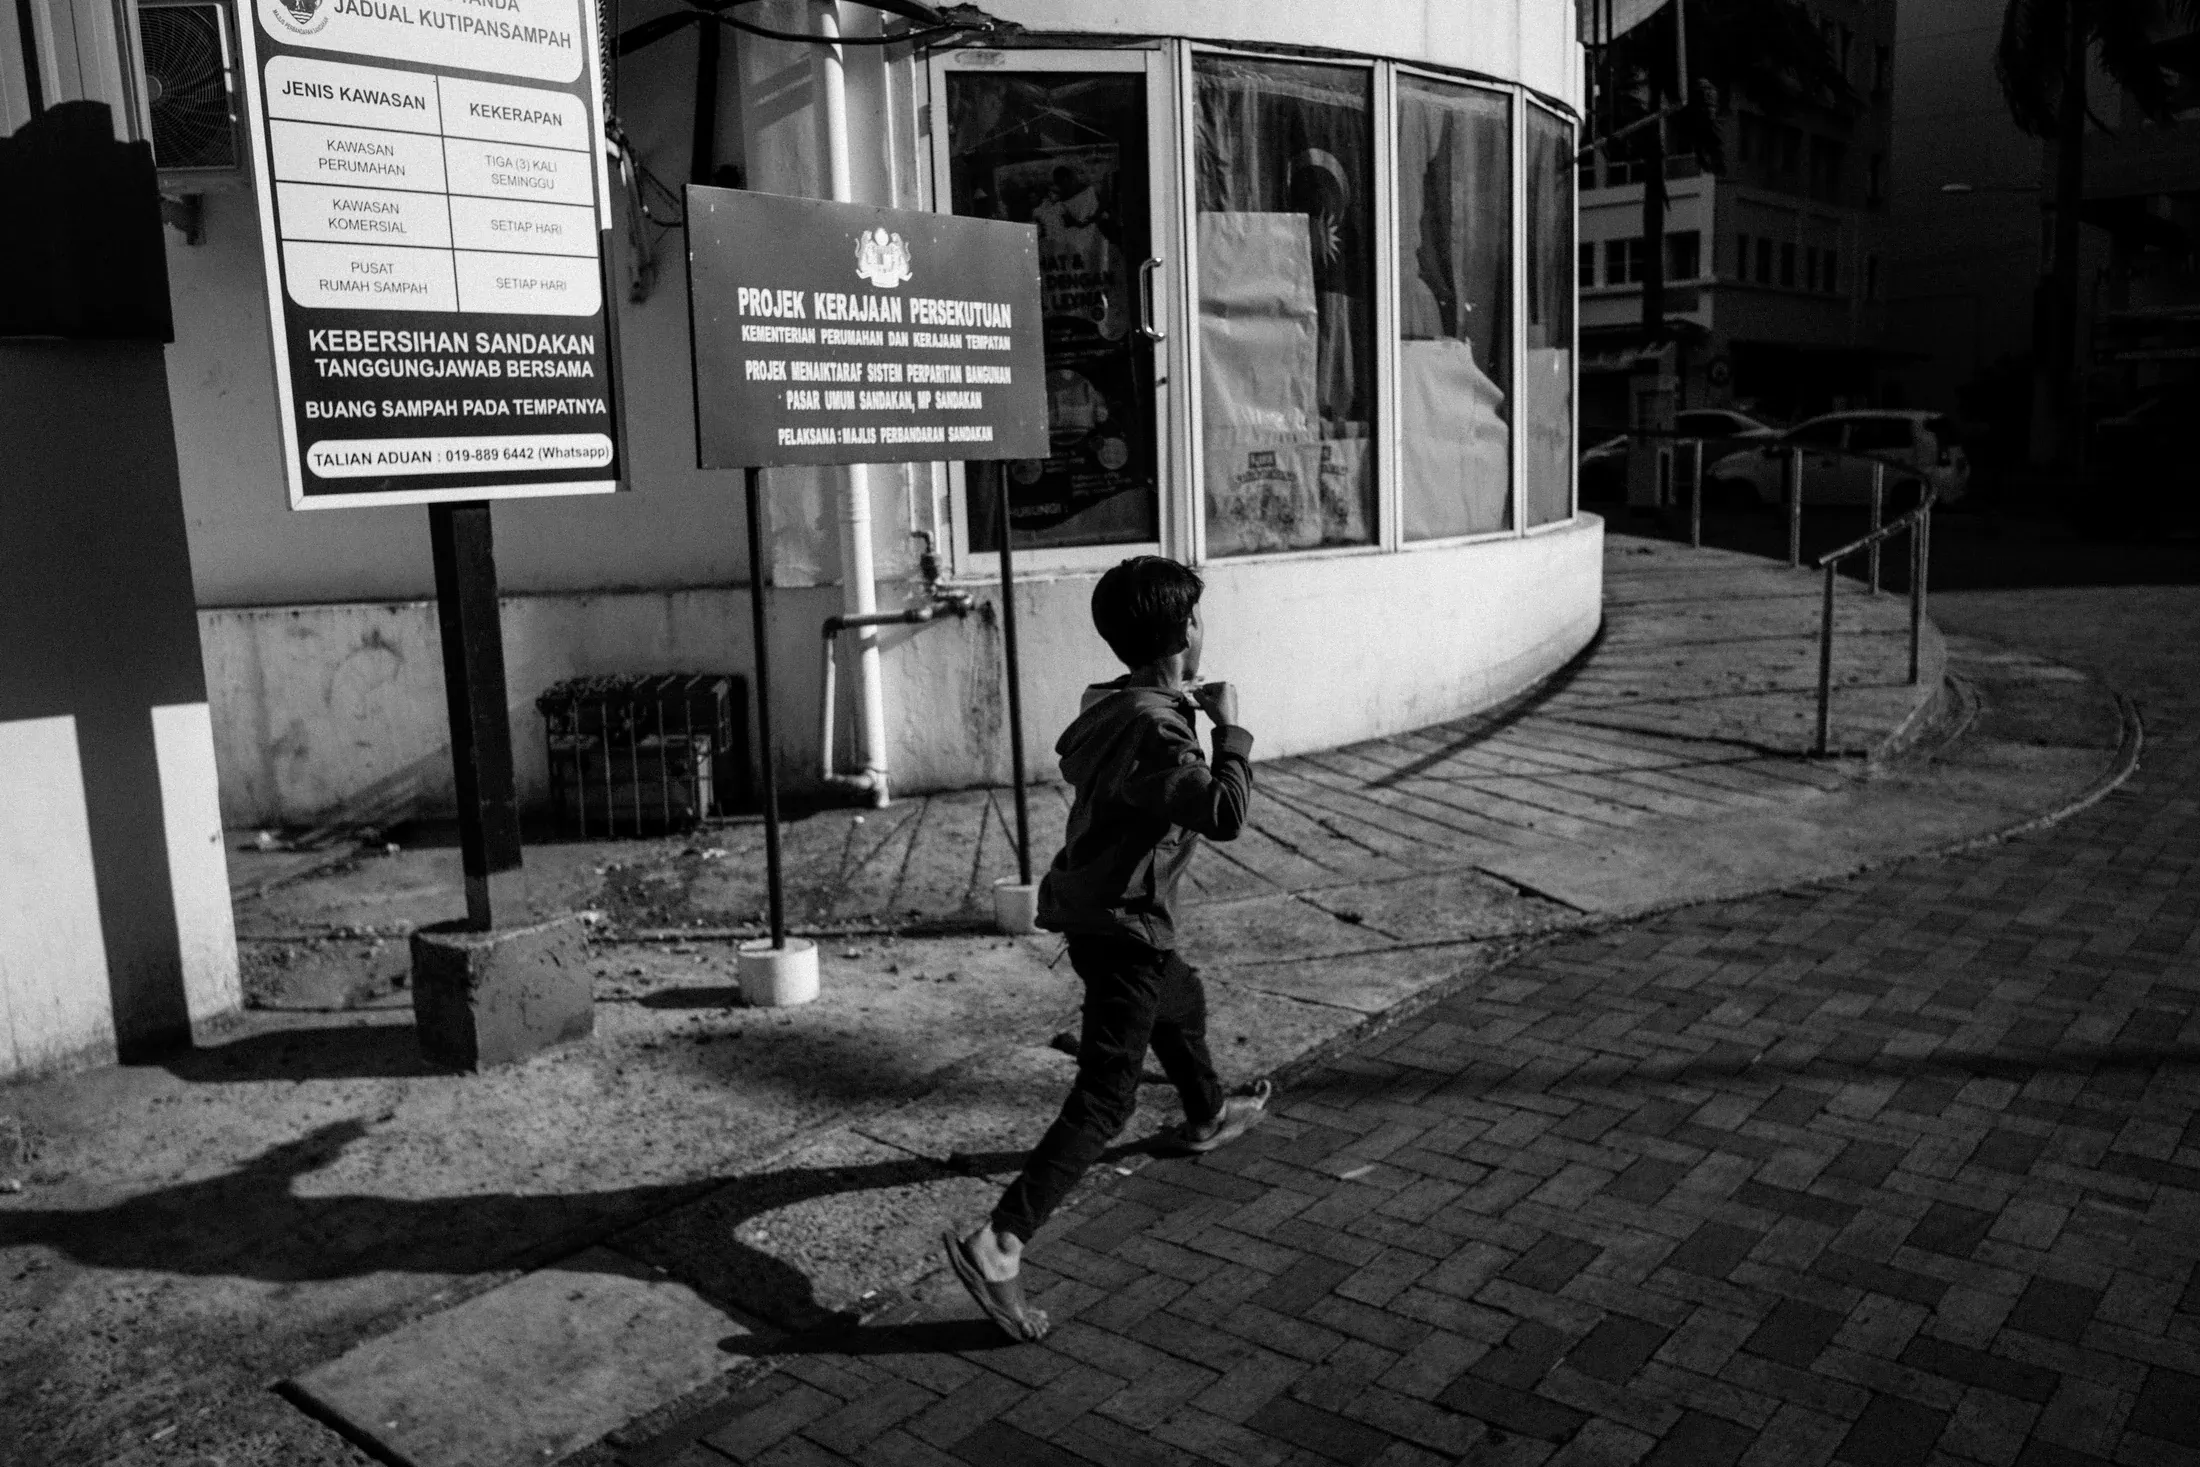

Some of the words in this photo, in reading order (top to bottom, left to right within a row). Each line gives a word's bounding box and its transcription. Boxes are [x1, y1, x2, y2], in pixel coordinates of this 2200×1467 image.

[334, 0, 414, 24] JADUAL
[282, 81, 333, 99] JENIS
[340, 87, 425, 109] KAWASAN
[470, 103, 562, 126] KEKERAPAN
[327, 140, 393, 156] KAWASAN
[319, 158, 405, 176] PERUMAHAN
[485, 155, 513, 168] TIGA
[516, 158, 530, 172] (3)
[533, 161, 557, 172] KALI
[492, 173, 554, 189] SEMINGGU
[333, 199, 399, 214] KAWASAN
[329, 218, 406, 233] KOMERSIAL
[491, 220, 532, 232] SETIAP
[536, 223, 561, 234] HARI
[351, 262, 394, 274] PUSAT
[320, 279, 369, 291] RUMAH
[374, 282, 427, 293] SAMPAH
[496, 277, 537, 289] SETIAP
[541, 280, 566, 290] HARI
[738, 287, 806, 318] PROJEK
[814, 292, 902, 323] KERAJAAN
[910, 298, 1011, 328] PERSEKUTUAN
[309, 330, 469, 353] KEBERSIHAN
[476, 333, 594, 354] SANDAKAN
[742, 325, 815, 343] KEMENTERIAN
[821, 329, 883, 346] PERUMAHAN
[888, 331, 908, 346] DAN
[913, 332, 962, 348] KERAJAAN
[315, 359, 501, 377] TANGGUNGJAWAB
[507, 360, 594, 377] BERSAMA
[746, 360, 787, 380] PROJEK
[791, 361, 862, 382] MENAIKTARAF
[867, 363, 902, 382] SISTEM
[907, 364, 962, 383] PERPARITAN
[306, 401, 376, 418] BUANG
[382, 400, 457, 417] SAMPAH
[463, 400, 509, 415] PADA
[513, 399, 606, 415] TEMPATNYA
[786, 390, 820, 410] PASAR
[825, 391, 855, 410] UMUM
[935, 391, 982, 409] SANDAKAN
[842, 427, 876, 444] MAJLIS
[880, 427, 944, 443] PERBANDARAN
[948, 426, 993, 442] SANDAKAN
[314, 453, 371, 466] TALIAN
[378, 451, 431, 464] ADUAN
[446, 449, 498, 462] 019-889
[504, 448, 533, 460] 6442
[539, 447, 609, 460] (Whatsapp)
